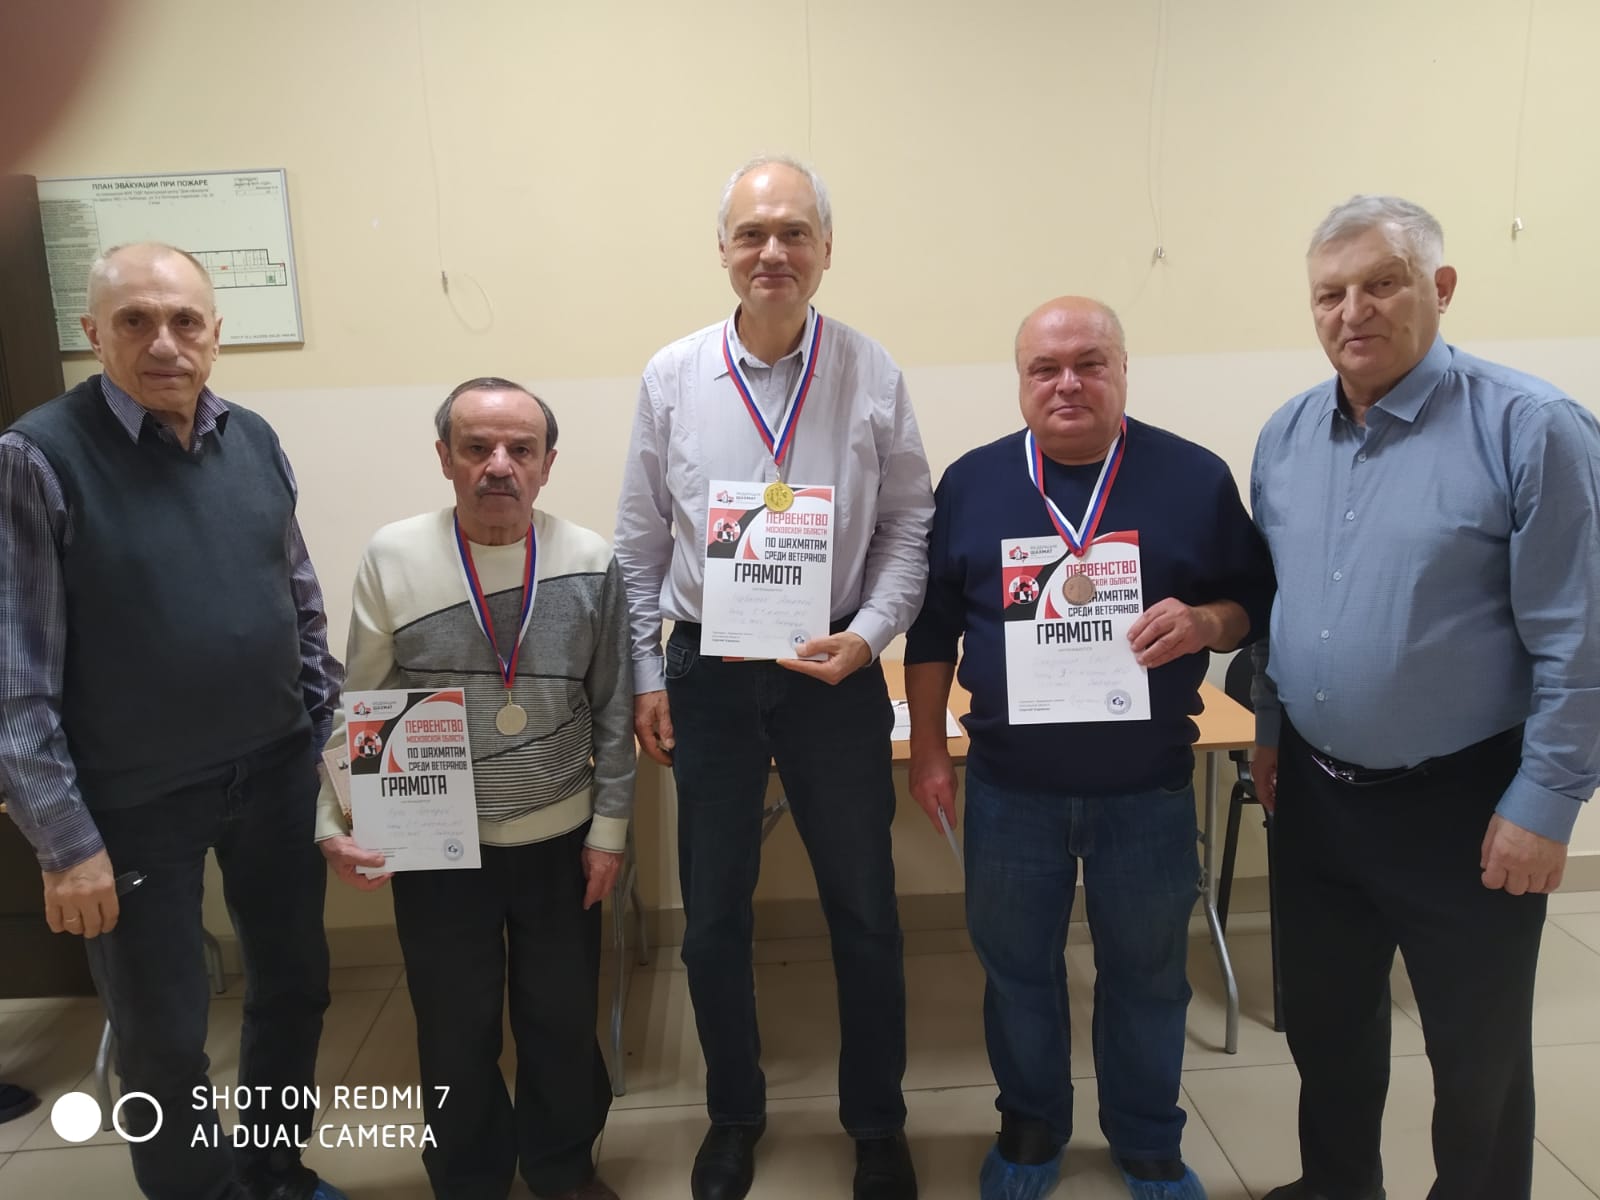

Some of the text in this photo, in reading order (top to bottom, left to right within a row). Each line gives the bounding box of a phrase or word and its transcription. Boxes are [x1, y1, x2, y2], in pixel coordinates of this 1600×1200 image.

[115, 181, 158, 190] ЭВАКУАЦИИ
[177, 179, 209, 187] ПОЖАРЕ
[766, 511, 828, 526] ПЕРВЕНСТВО
[765, 537, 827, 550] ПО ШАХМАТАМ
[765, 550, 827, 563] СРЕДИ ВЕТЕРАНОВ
[734, 562, 802, 586] ГРАМОТА
[1066, 560, 1137, 577] ПЕРВЕНСТВО
[1109, 576, 1138, 586] ОБЛАСТИ
[1089, 588, 1138, 602] АХМАТАМ
[1068, 603, 1140, 617] СРЕДИ ВЕТЕРАНОВ
[1036, 619, 1113, 645] ГРАМОТА
[405, 719, 464, 733] ПЕРВЕНСТВО
[407, 746, 466, 759] ПО ШАХМАТАМ
[408, 760, 468, 771] СРЕДИ ВЕТЕРАНОВ
[381, 774, 448, 797] ГРАМОТА
